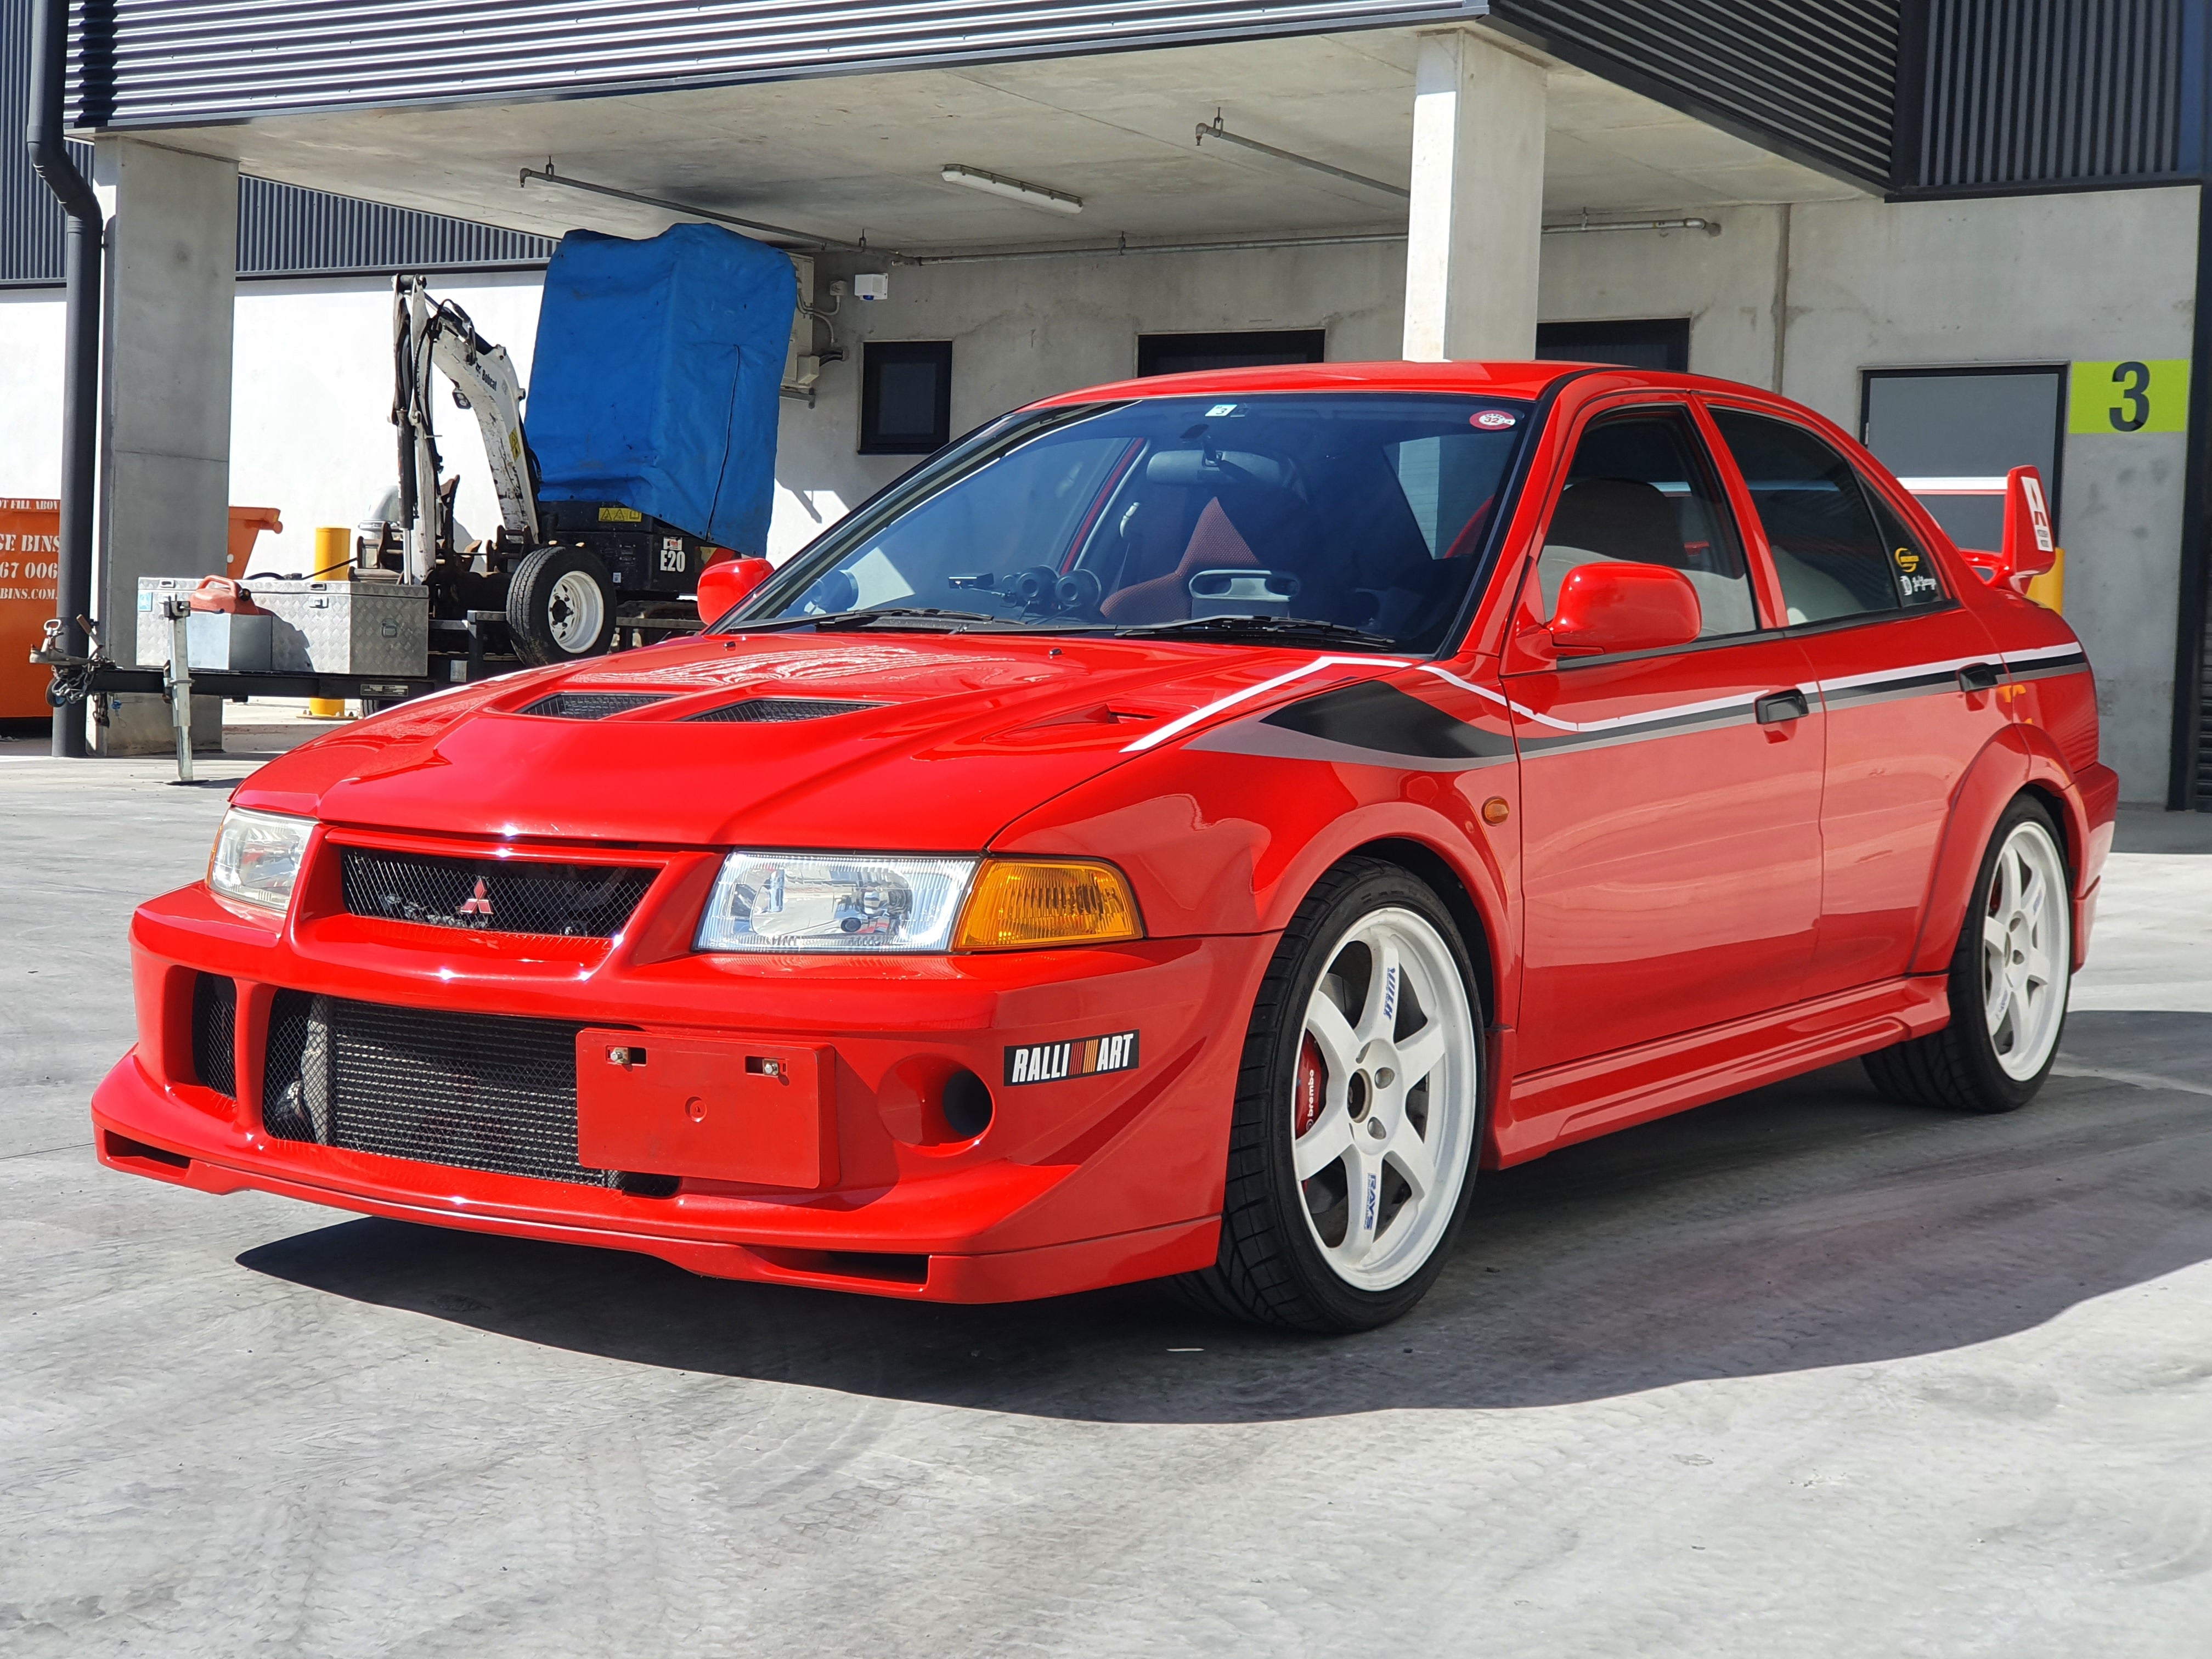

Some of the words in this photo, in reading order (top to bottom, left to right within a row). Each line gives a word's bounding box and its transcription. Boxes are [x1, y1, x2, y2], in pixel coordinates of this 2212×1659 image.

[482, 369, 497, 392] Bobcat
[2109, 362, 2150, 432] 3
[11, 500, 31, 510] FILL
[21, 534, 60, 553] BINS
[0, 561, 20, 579] 67
[25, 562, 58, 579] 006
[660, 550, 686, 572] E20
[1366, 1174, 1376, 1229] RAYS
